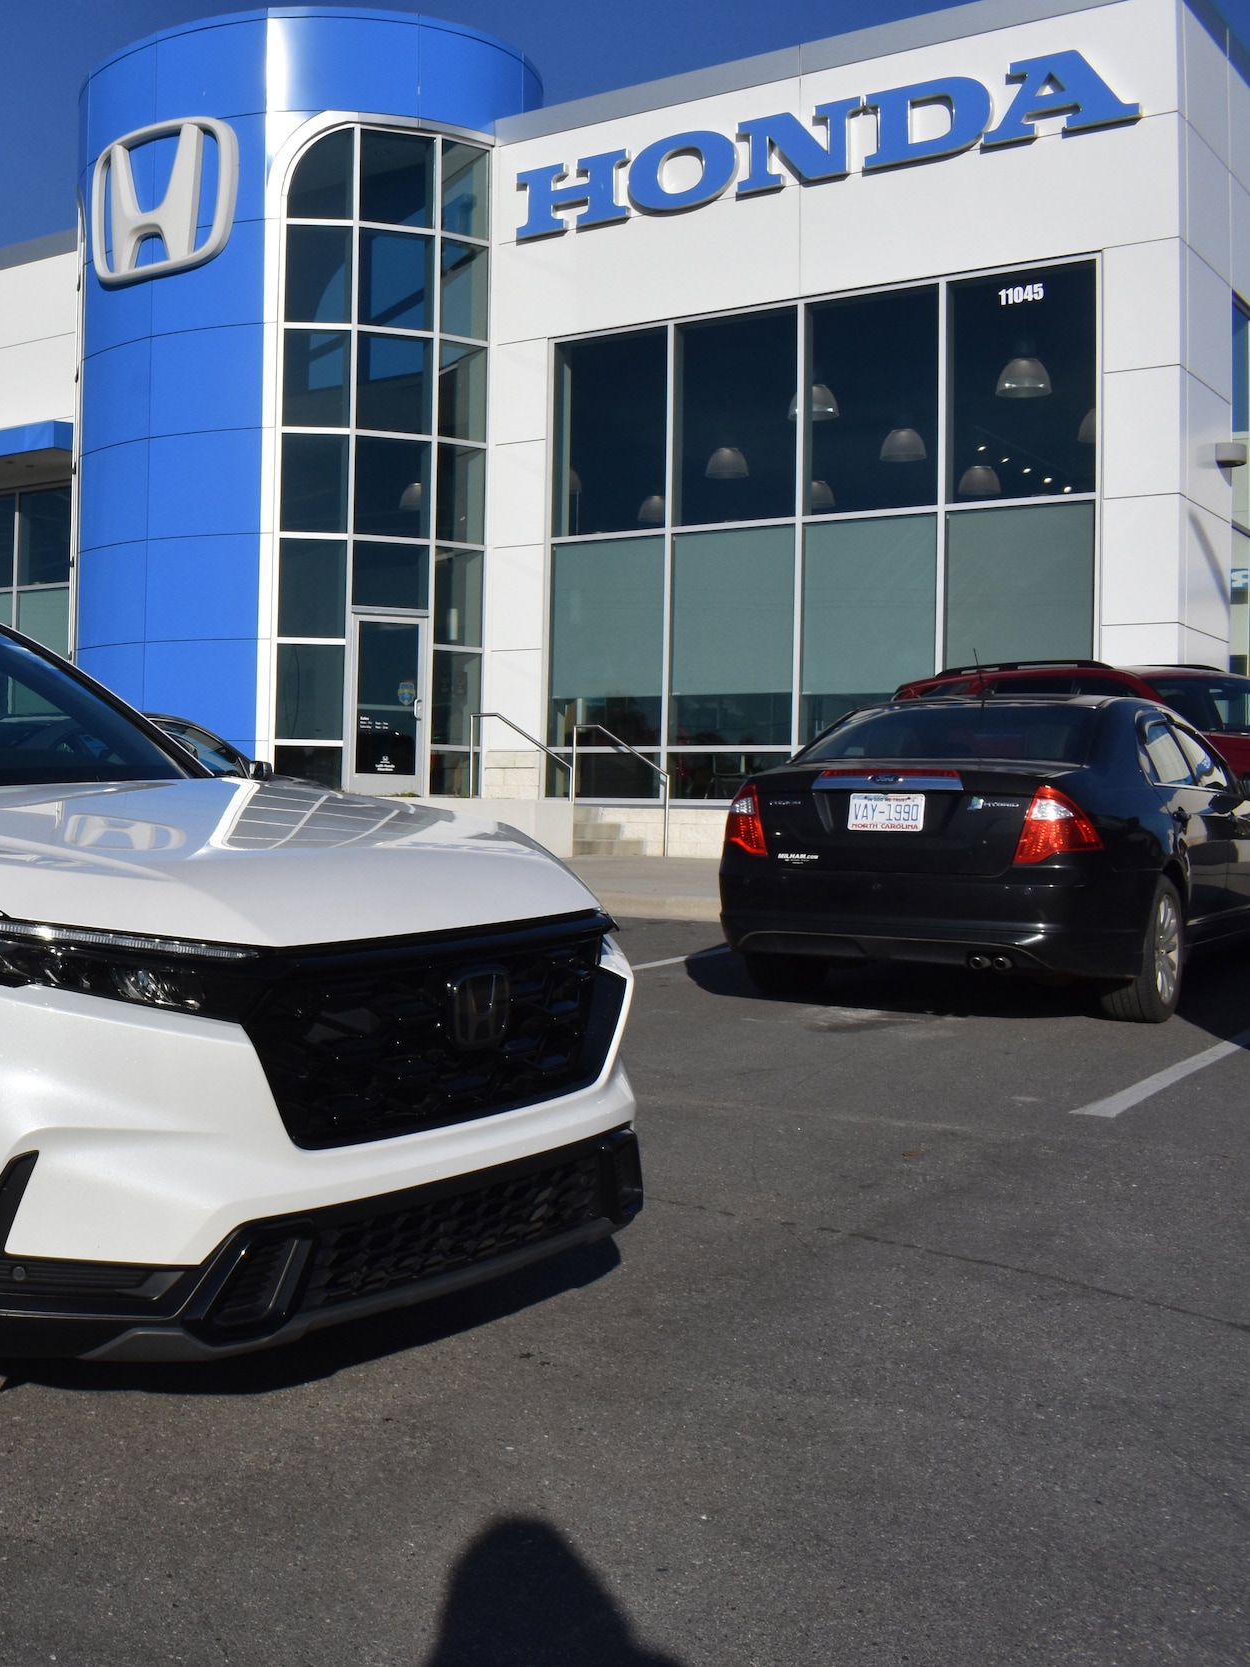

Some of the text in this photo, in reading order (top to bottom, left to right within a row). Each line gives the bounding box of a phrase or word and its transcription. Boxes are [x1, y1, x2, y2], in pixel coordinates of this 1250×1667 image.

[516, 49, 1141, 240] HONDA
[998, 283, 1044, 306] 11045
[854, 803, 920, 822] VAY-1990
